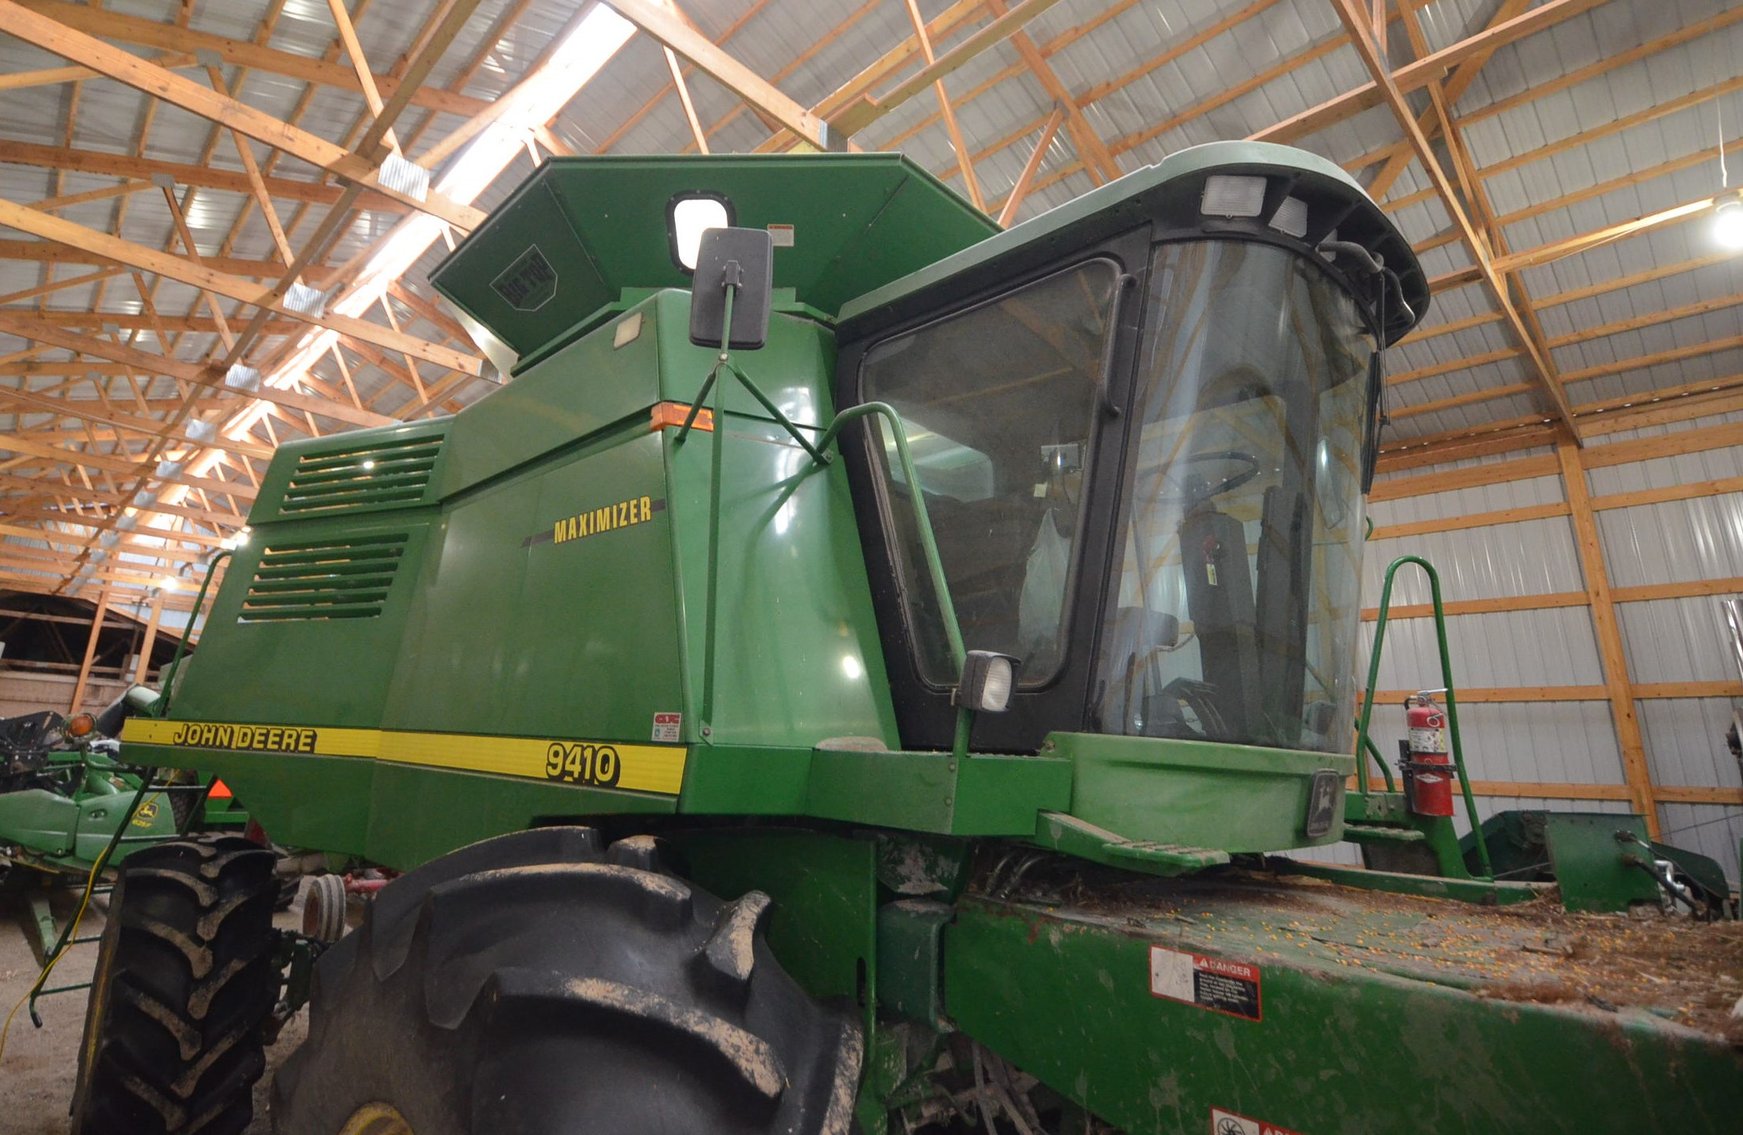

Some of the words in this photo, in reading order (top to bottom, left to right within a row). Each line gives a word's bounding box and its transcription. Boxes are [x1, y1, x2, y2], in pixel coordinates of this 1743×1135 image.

[554, 495, 652, 544] MAXIMIZER
[173, 723, 234, 748] JOHN
[237, 727, 317, 753] DEERE
[546, 742, 621, 788] 9410
[1209, 960, 1251, 977] DANGER
